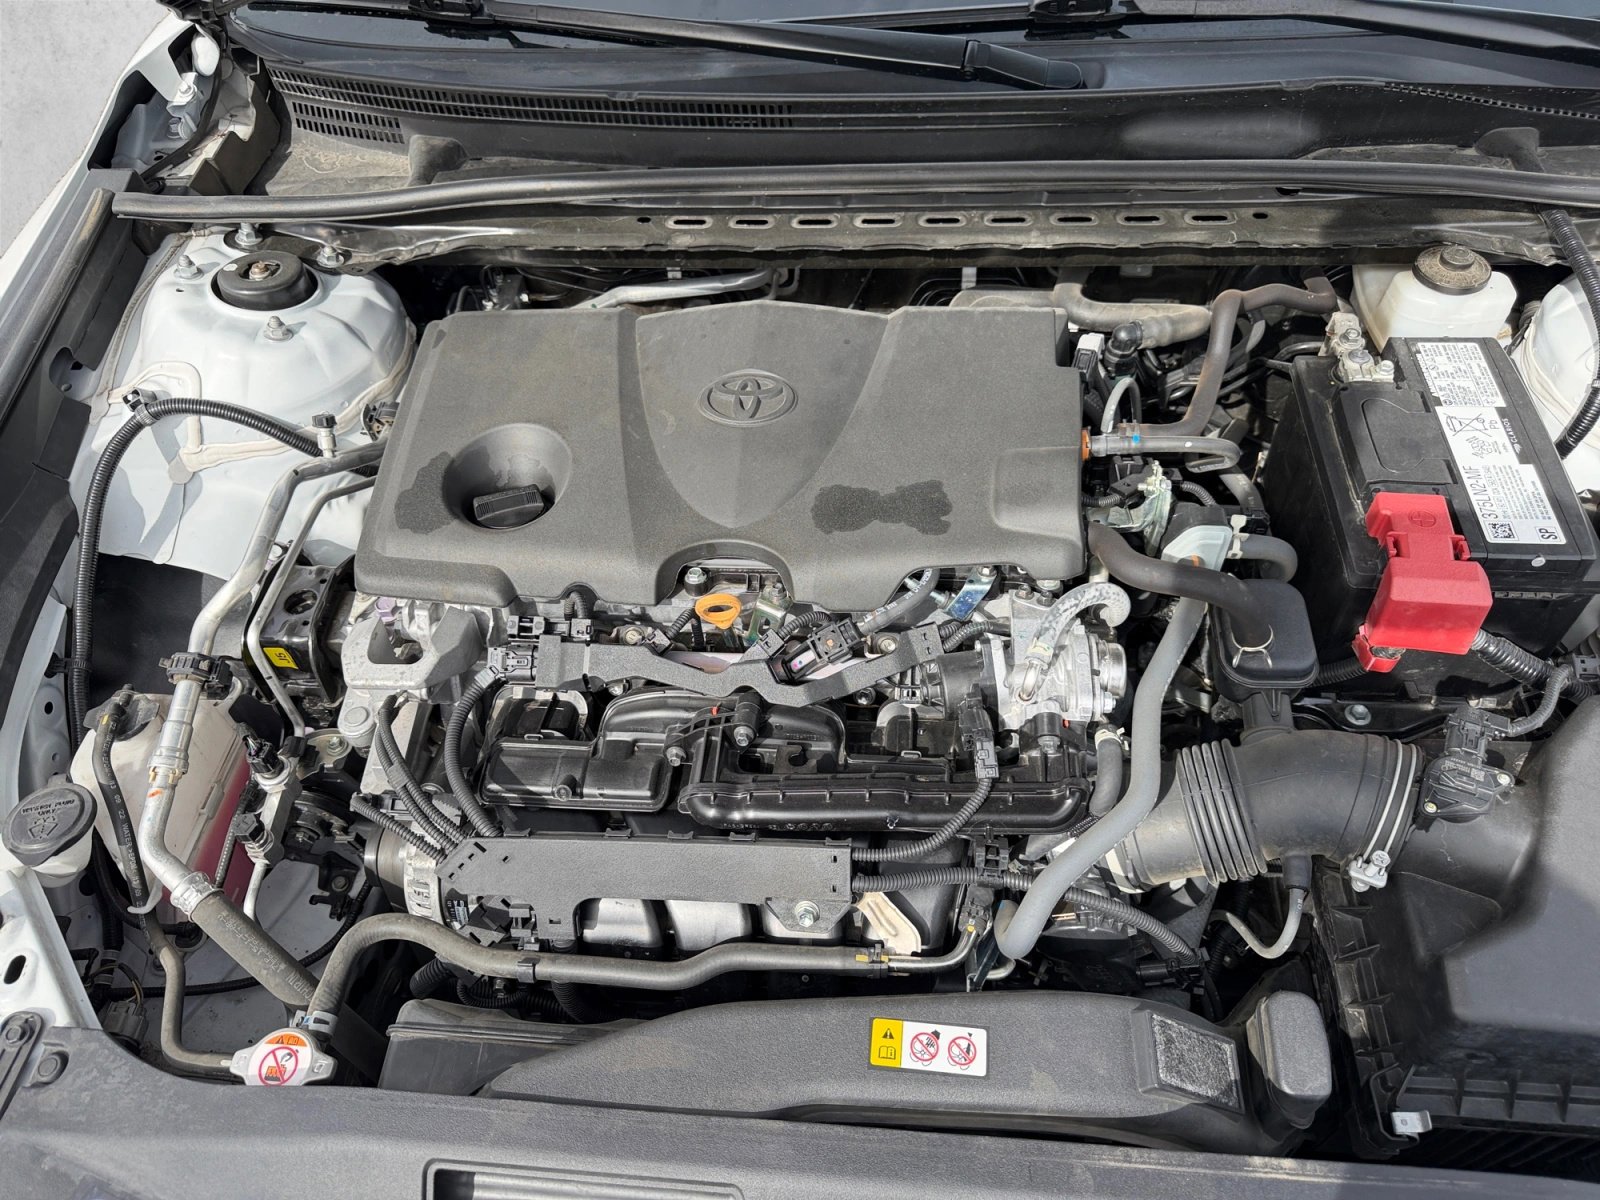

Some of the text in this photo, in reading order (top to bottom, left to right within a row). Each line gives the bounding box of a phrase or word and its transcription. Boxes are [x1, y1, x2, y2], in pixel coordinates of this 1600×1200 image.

[1488, 419, 1500, 430] Pb
[1502, 417, 1517, 445] CLARIOS
[1462, 464, 1499, 520] 375LN2-MF
[1540, 527, 1558, 541] SP
[121, 822, 133, 850] WATER
